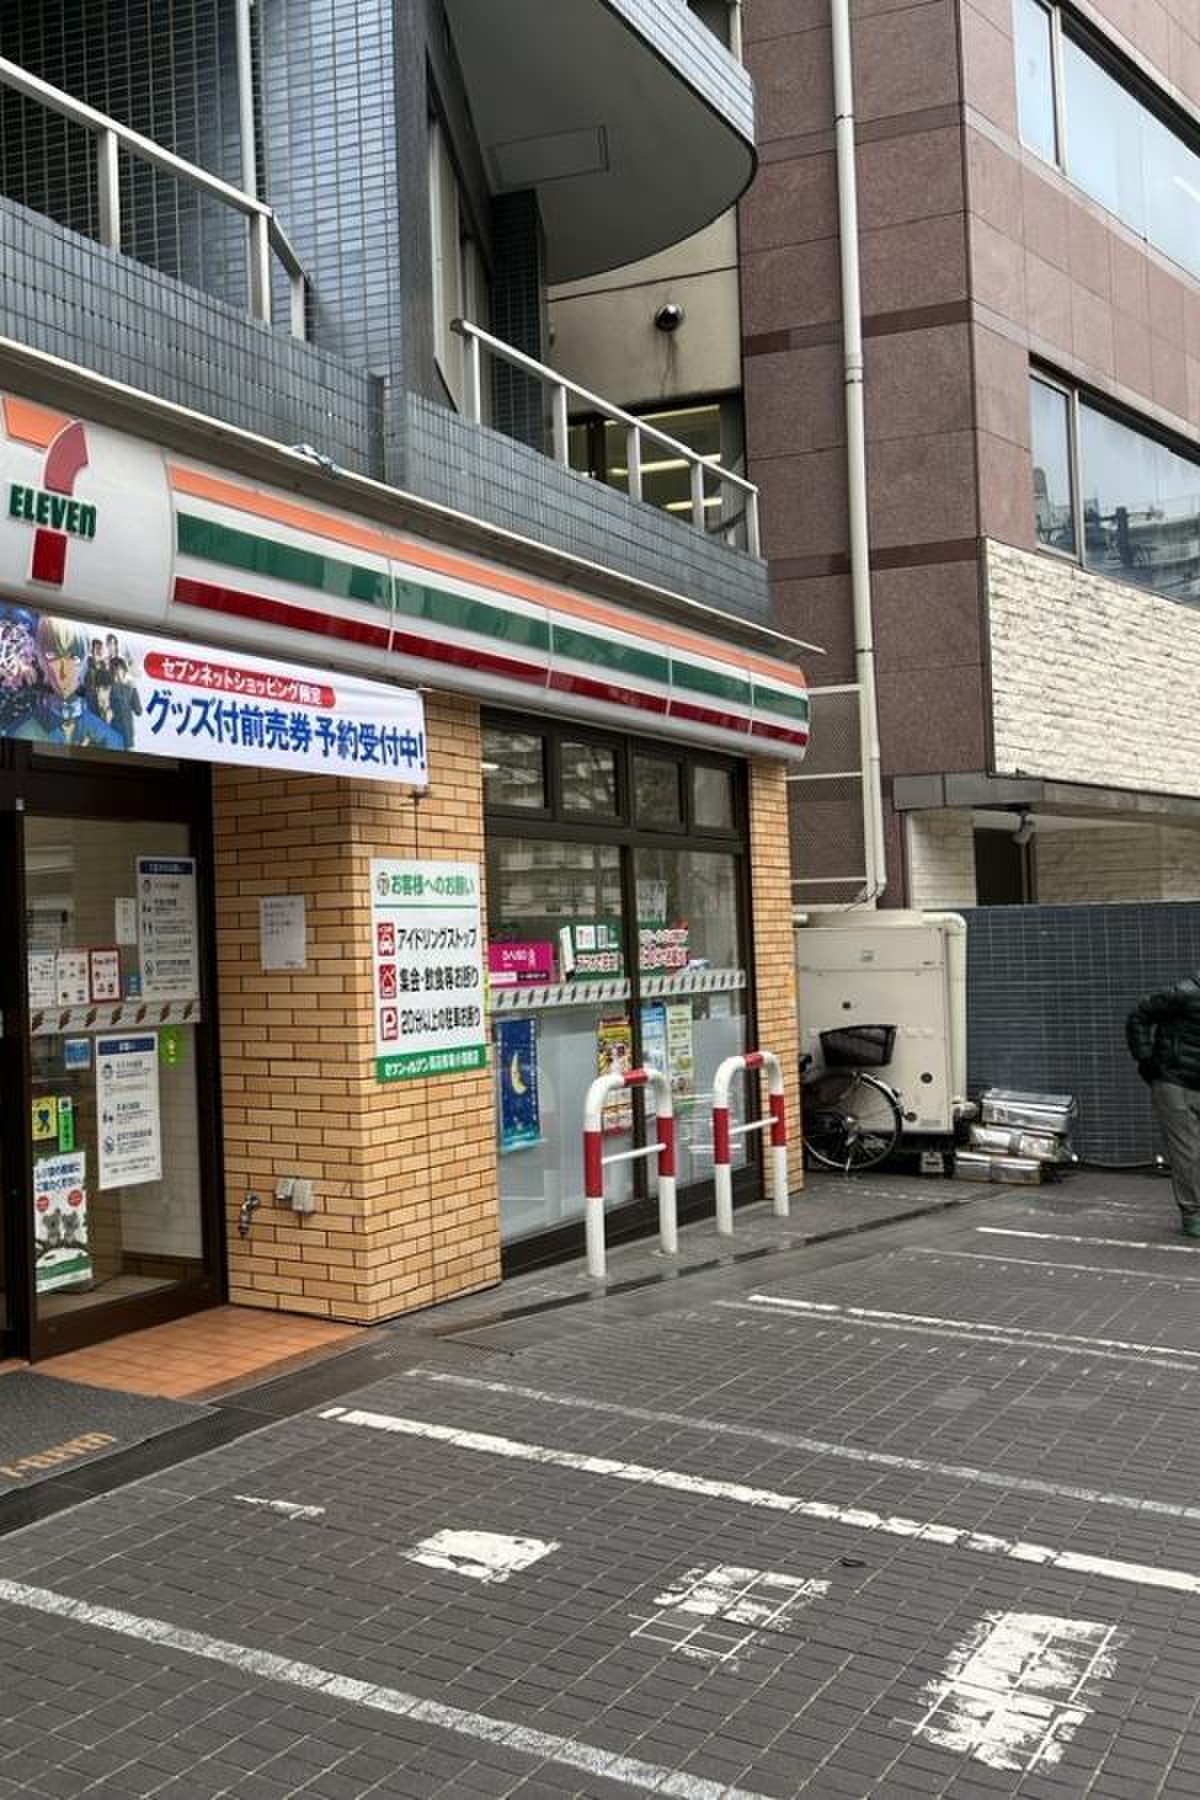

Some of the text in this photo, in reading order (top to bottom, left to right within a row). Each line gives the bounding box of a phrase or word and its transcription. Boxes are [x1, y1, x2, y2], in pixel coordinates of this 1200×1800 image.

[397, 927, 477, 950] アイドリングストップ
